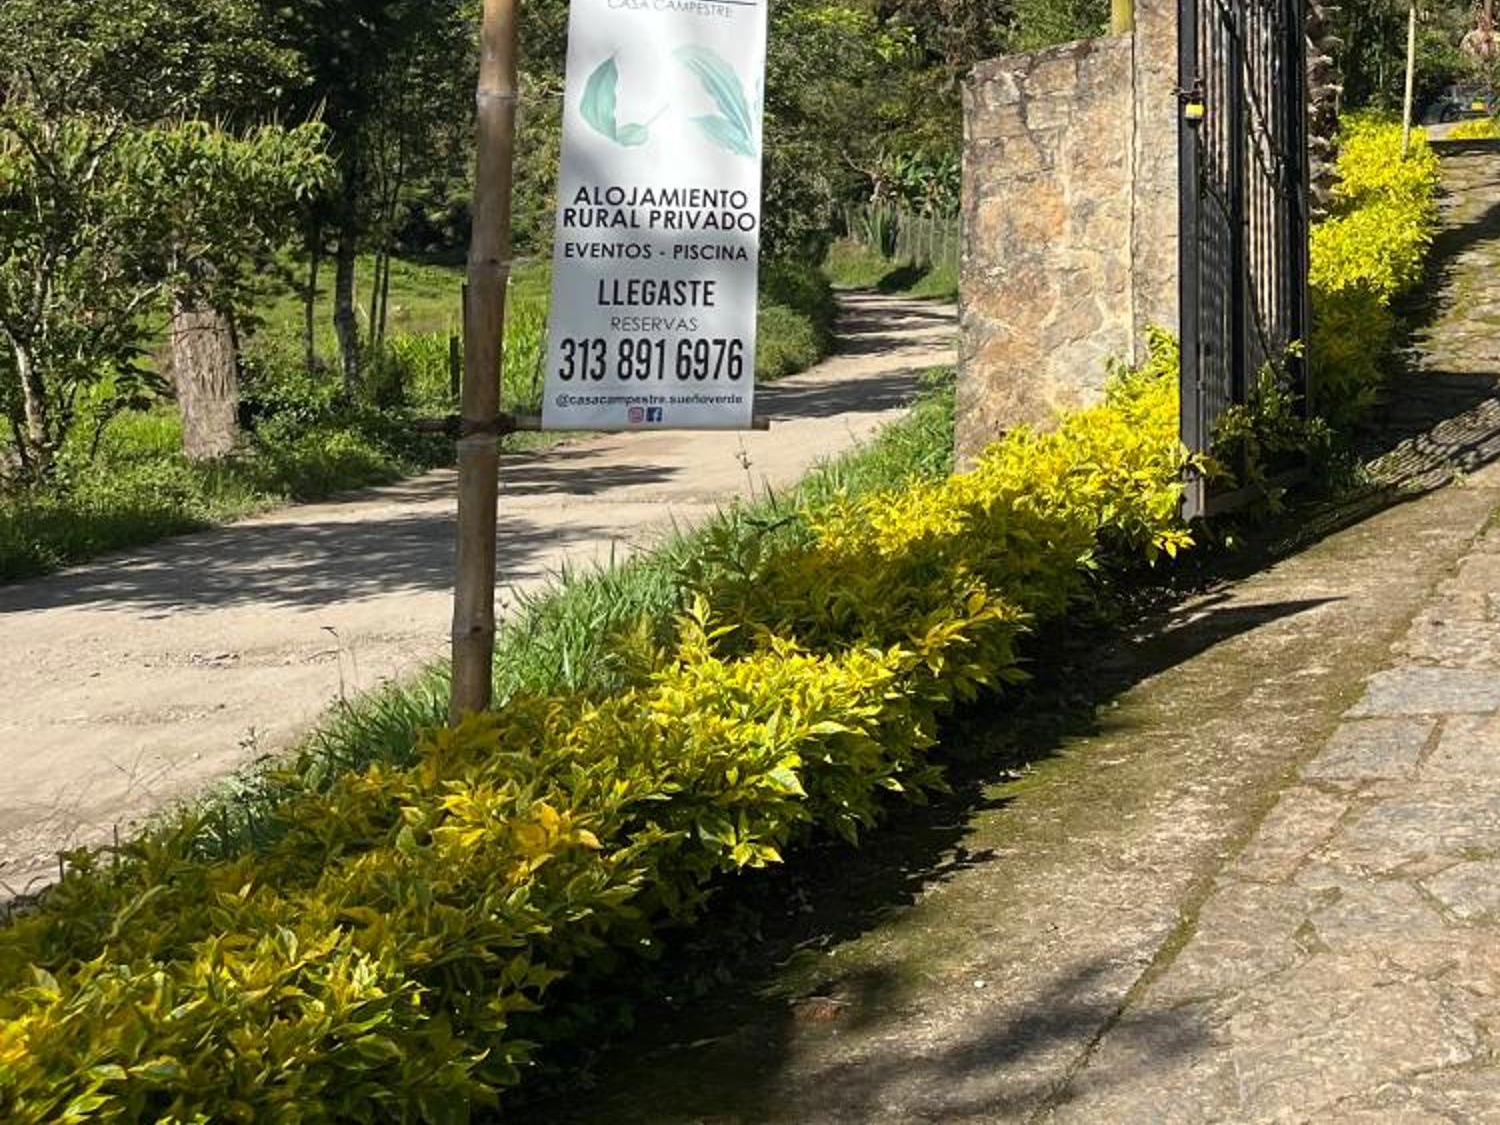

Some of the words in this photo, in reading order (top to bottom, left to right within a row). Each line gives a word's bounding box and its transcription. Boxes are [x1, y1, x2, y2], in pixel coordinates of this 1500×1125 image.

[652, 0, 733, 18] CAMPESTRE
[573, 186, 748, 209] ALOJAMIENTO
[563, 208, 641, 228] RURAL
[649, 210, 756, 232] PRIVADO
[565, 242, 652, 260] EVENTOS
[673, 244, 749, 261] PISCINA
[598, 279, 717, 307] LLEGASTE
[611, 317, 698, 332] RESERVAS
[559, 338, 607, 381] 313
[617, 338, 666, 381] 891
[675, 338, 743, 381] 6976
